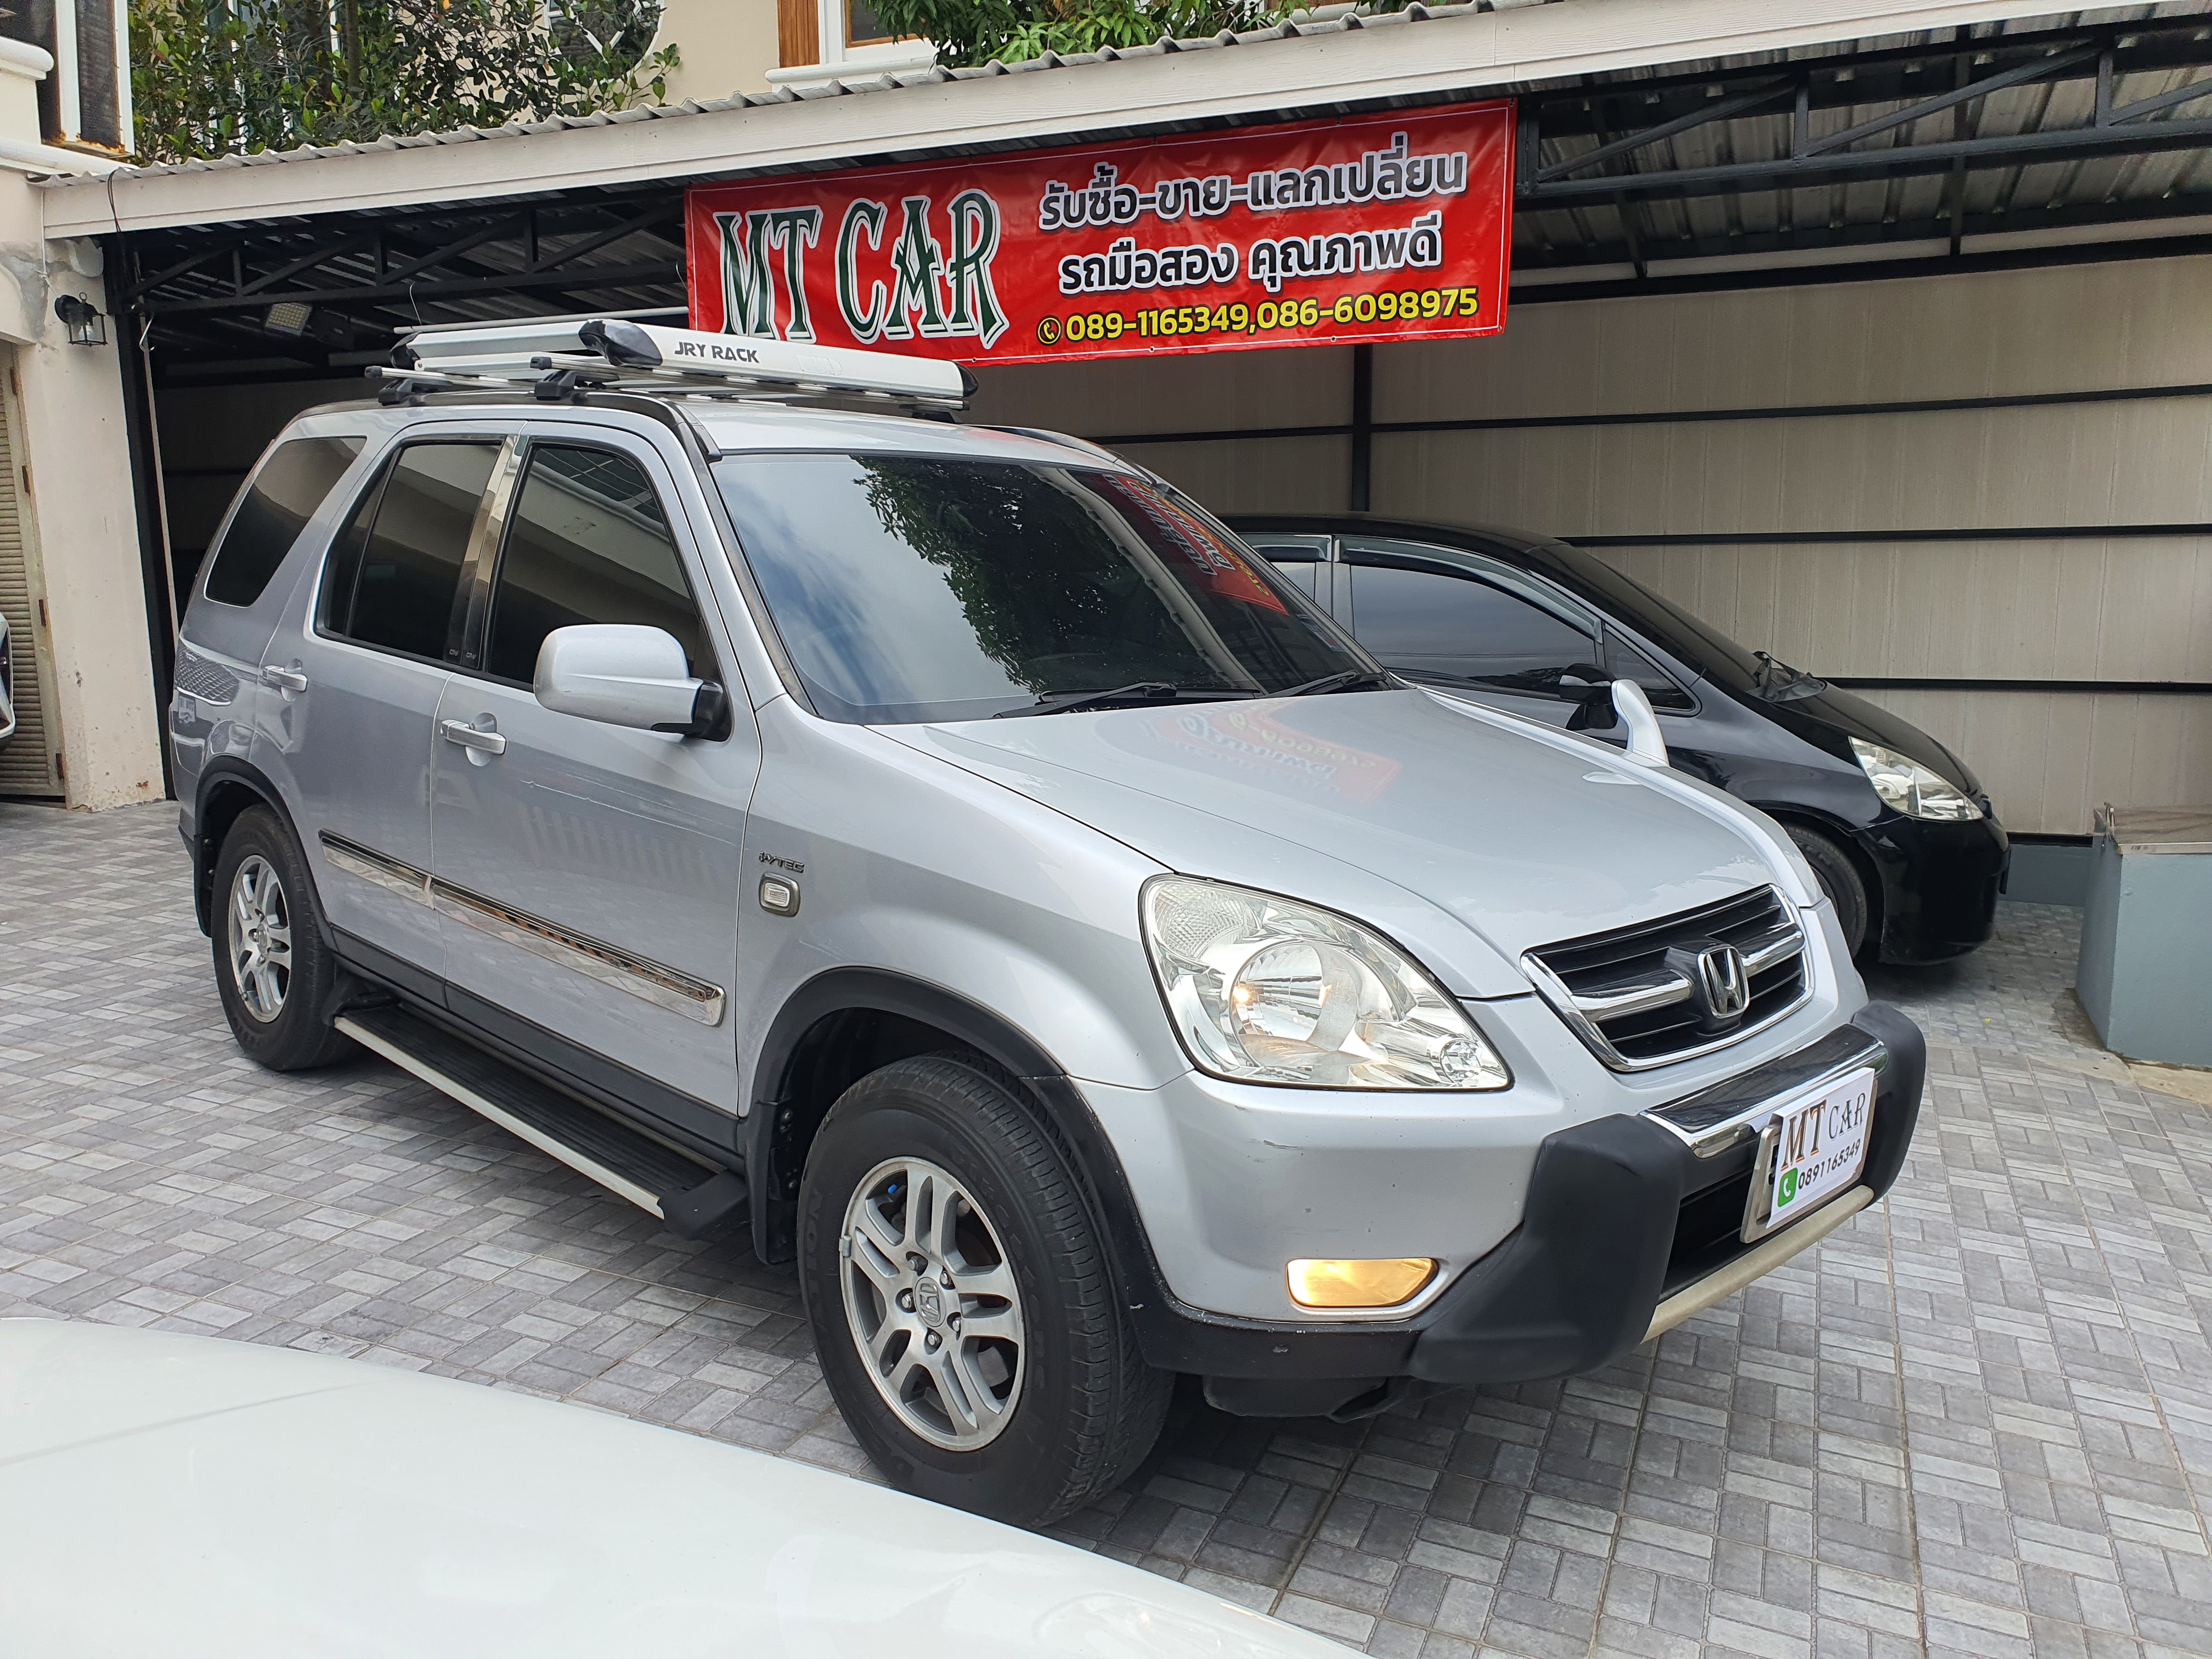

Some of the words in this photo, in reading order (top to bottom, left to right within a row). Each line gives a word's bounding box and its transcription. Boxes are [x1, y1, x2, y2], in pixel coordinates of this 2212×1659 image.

[713, 205, 822, 344] MT
[835, 189, 1009, 349] CAR
[1059, 236, 1239, 295] รถมือสอง
[1248, 210, 1442, 292] คุณภาพดี
[674, 341, 706, 358] JRY
[711, 345, 760, 364] RACK
[1780, 1098, 1827, 1172] MT
[1829, 1092, 1866, 1141] CAR
[1798, 1138, 1861, 1190] 0891165349
